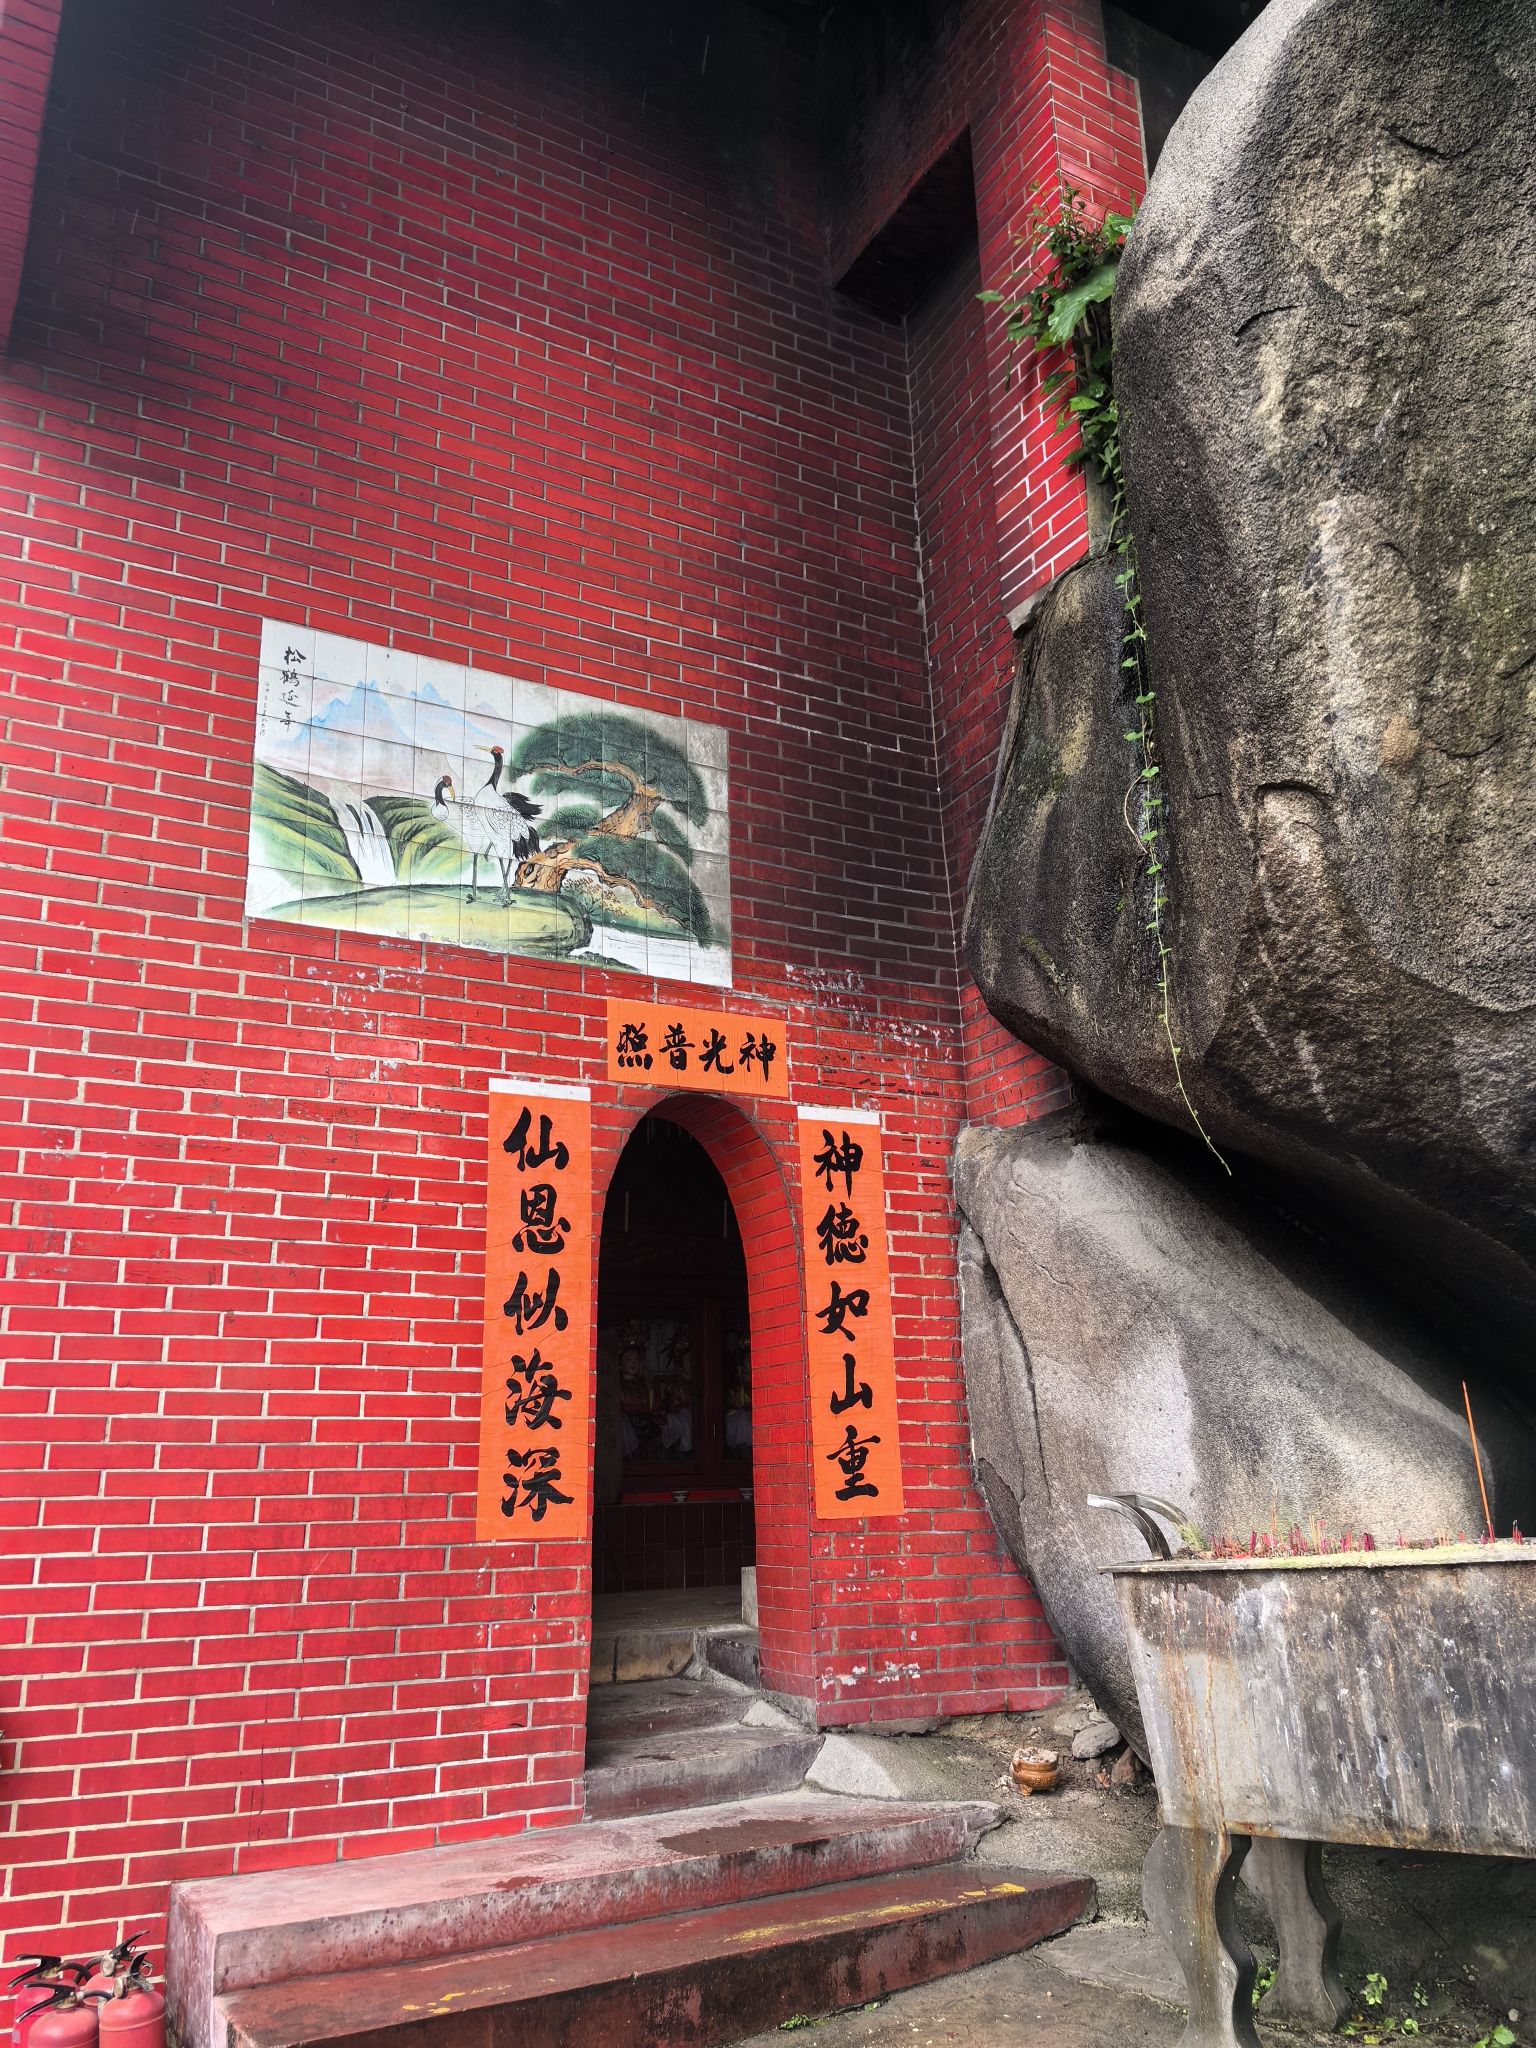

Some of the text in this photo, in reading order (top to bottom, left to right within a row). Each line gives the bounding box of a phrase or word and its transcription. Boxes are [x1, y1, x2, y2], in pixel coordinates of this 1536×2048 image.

[501, 1106, 575, 1521] 仙恩似海深
